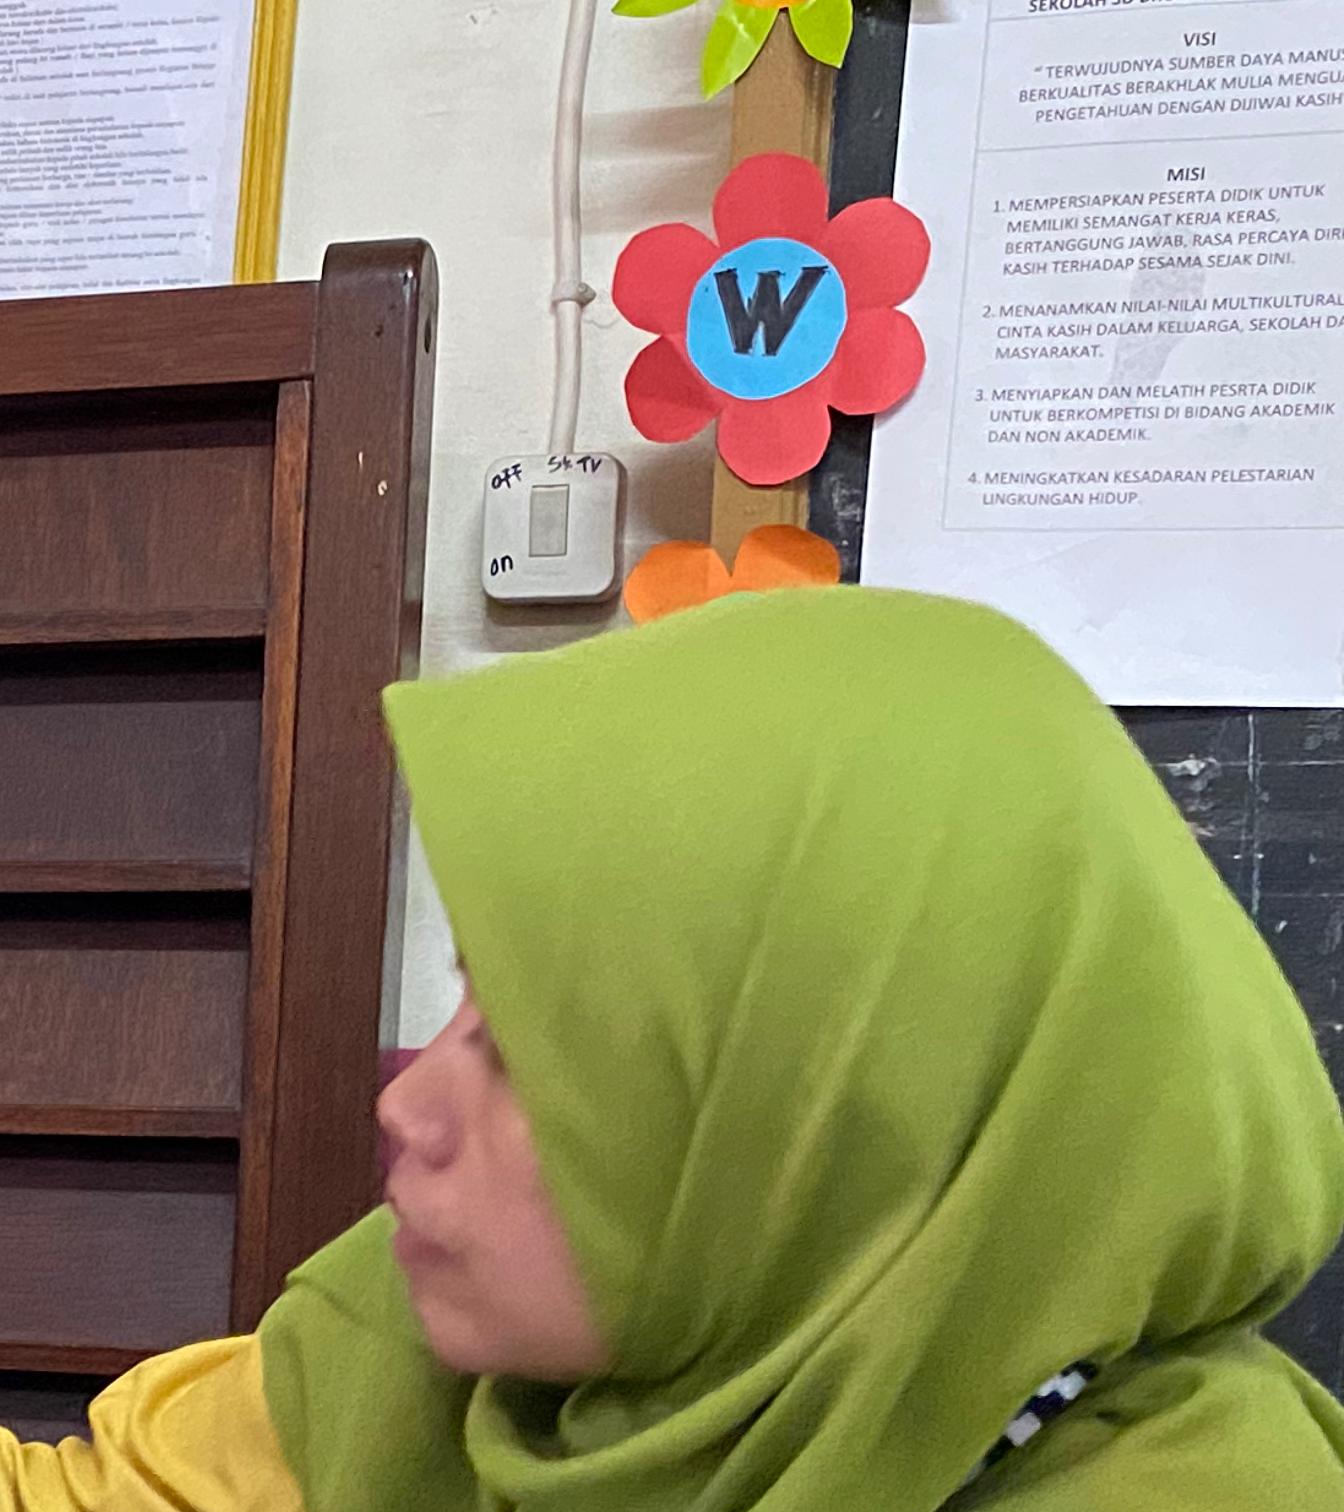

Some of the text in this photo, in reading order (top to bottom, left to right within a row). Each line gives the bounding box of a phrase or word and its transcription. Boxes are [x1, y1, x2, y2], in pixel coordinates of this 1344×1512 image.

[1184, 32, 1216, 47] VISI
[1046, 58, 1164, 79] TERWUJUDNYA
[1169, 55, 1235, 71] SUMBER
[1241, 53, 1284, 67] DAYA
[1019, 83, 1121, 102] BERKUALITAS
[1126, 78, 1216, 95] BERAKHLAK
[1221, 75, 1272, 89] MULIA
[1036, 103, 1152, 122] PENGETAHUAN
[1158, 99, 1225, 115] DENGAN
[1167, 167, 1205, 181] MISI
[1009, 193, 1144, 211] MEMPERSIAPKAN
[1149, 190, 1215, 205] PESERTA
[1221, 188, 1264, 202] DIDIK
[1269, 184, 1325, 200] UNTUK
[1007, 208, 1280, 233] MEMILIKI SEMANGAT KERJA KERAS,
[1005, 237, 1124, 254] BERTANGGUNG
[1128, 235, 1187, 249] JAWAB,
[1192, 233, 1232, 246] RASA
[1238, 229, 1309, 245] PERCAYA
[1003, 252, 1294, 275] KASIH TERHADAP SESAMA SEJAK DINI.
[714, 264, 828, 357] W
[1000, 301, 1117, 317] MENANAMKAN
[1121, 299, 1207, 313] NILAI-NILAI
[997, 326, 1042, 339] CINTA
[1047, 324, 1092, 337] KASIH
[1096, 322, 1153, 336] DALAM
[1158, 319, 1243, 333] KELUARGA,
[1249, 316, 1321, 331] SEKOLAH
[996, 344, 1103, 359] MASYARAKAT.
[992, 388, 1093, 401] MENYIAPKAN
[1098, 386, 1131, 399] DAN
[1137, 385, 1205, 398] MELATIH
[1273, 382, 1316, 395] DIDIK
[990, 403, 1335, 422] UNTUK BERKOMPETISI DI BIDANG AKADEMIK
[988, 430, 1020, 443] DAN
[1025, 430, 1060, 443] NON
[577, 455, 602, 473] TV
[985, 472, 1109, 485] MENINGKATKAN
[1114, 470, 1206, 483] KESADARAN
[1211, 469, 1314, 482] PELESTARIAN
[983, 493, 1084, 505] LINGKUNGAN
